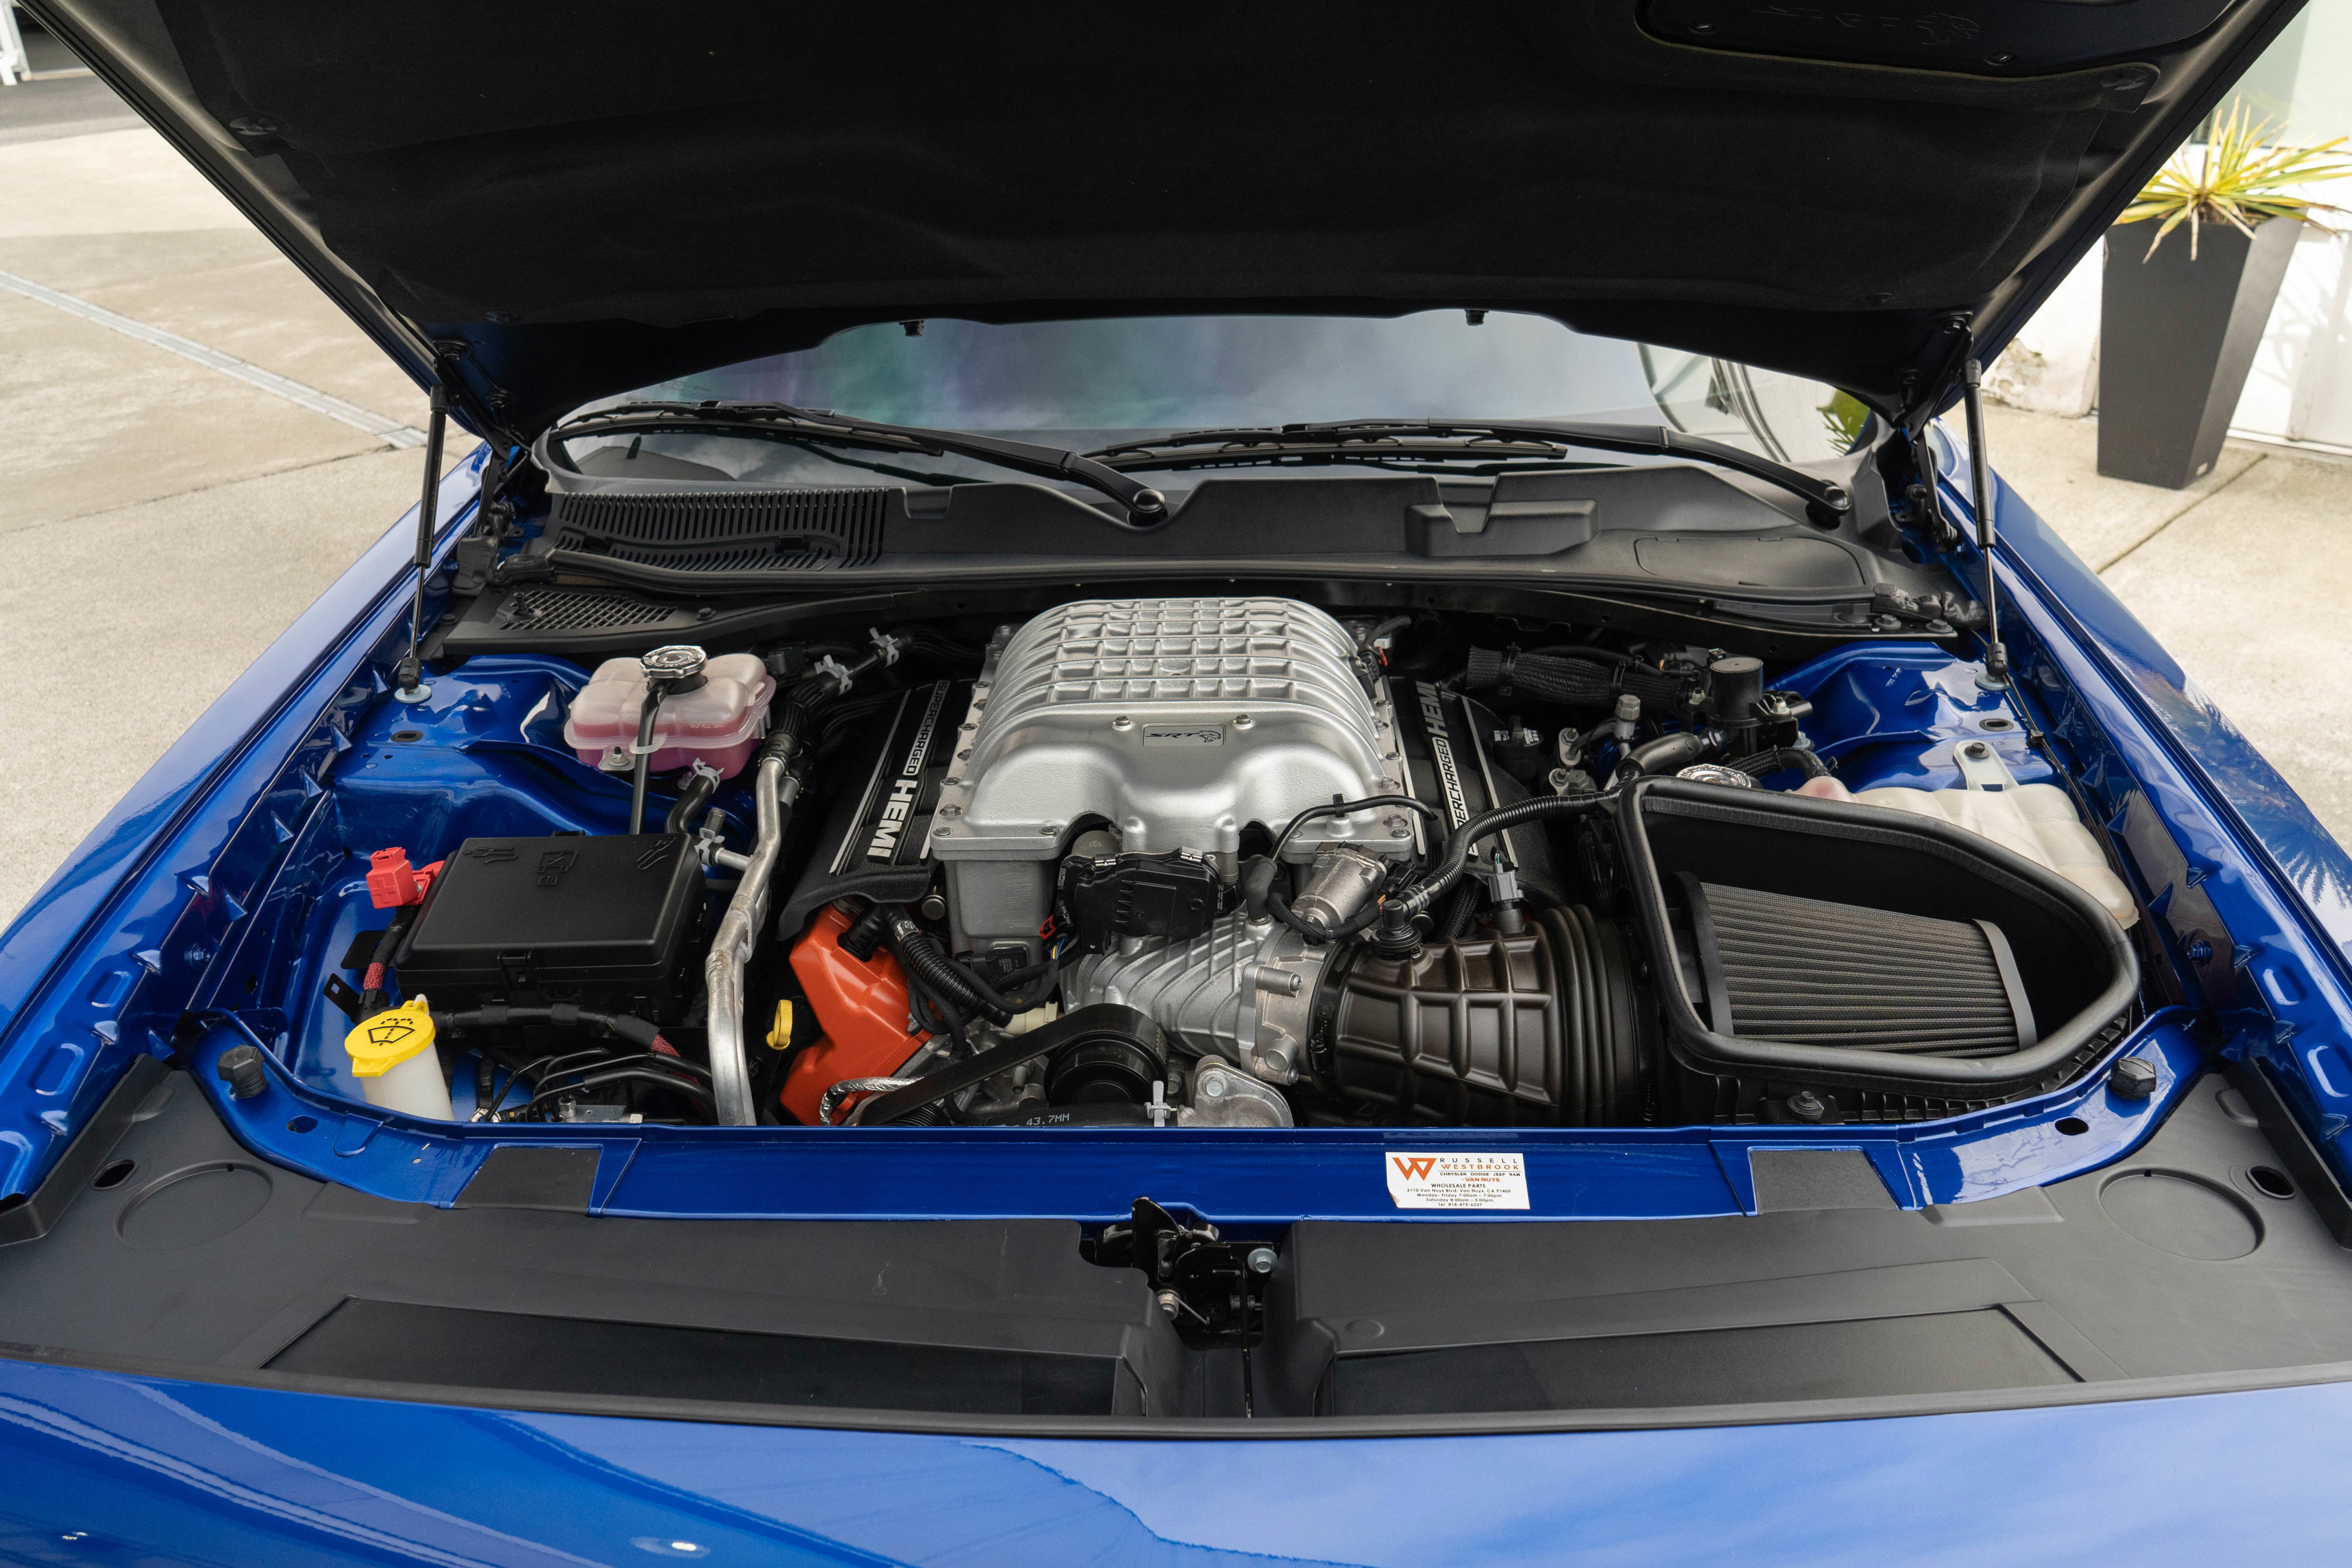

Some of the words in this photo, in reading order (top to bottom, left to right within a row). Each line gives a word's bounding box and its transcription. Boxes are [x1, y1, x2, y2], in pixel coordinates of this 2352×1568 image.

[906, 681, 950, 775] SUPERCHARGED
[1415, 681, 1448, 738] HEMI
[866, 779, 918, 858] HEMI
[1434, 737, 1475, 853] ERCHARGED
[1026, 1113, 1070, 1126] 43.7MM
